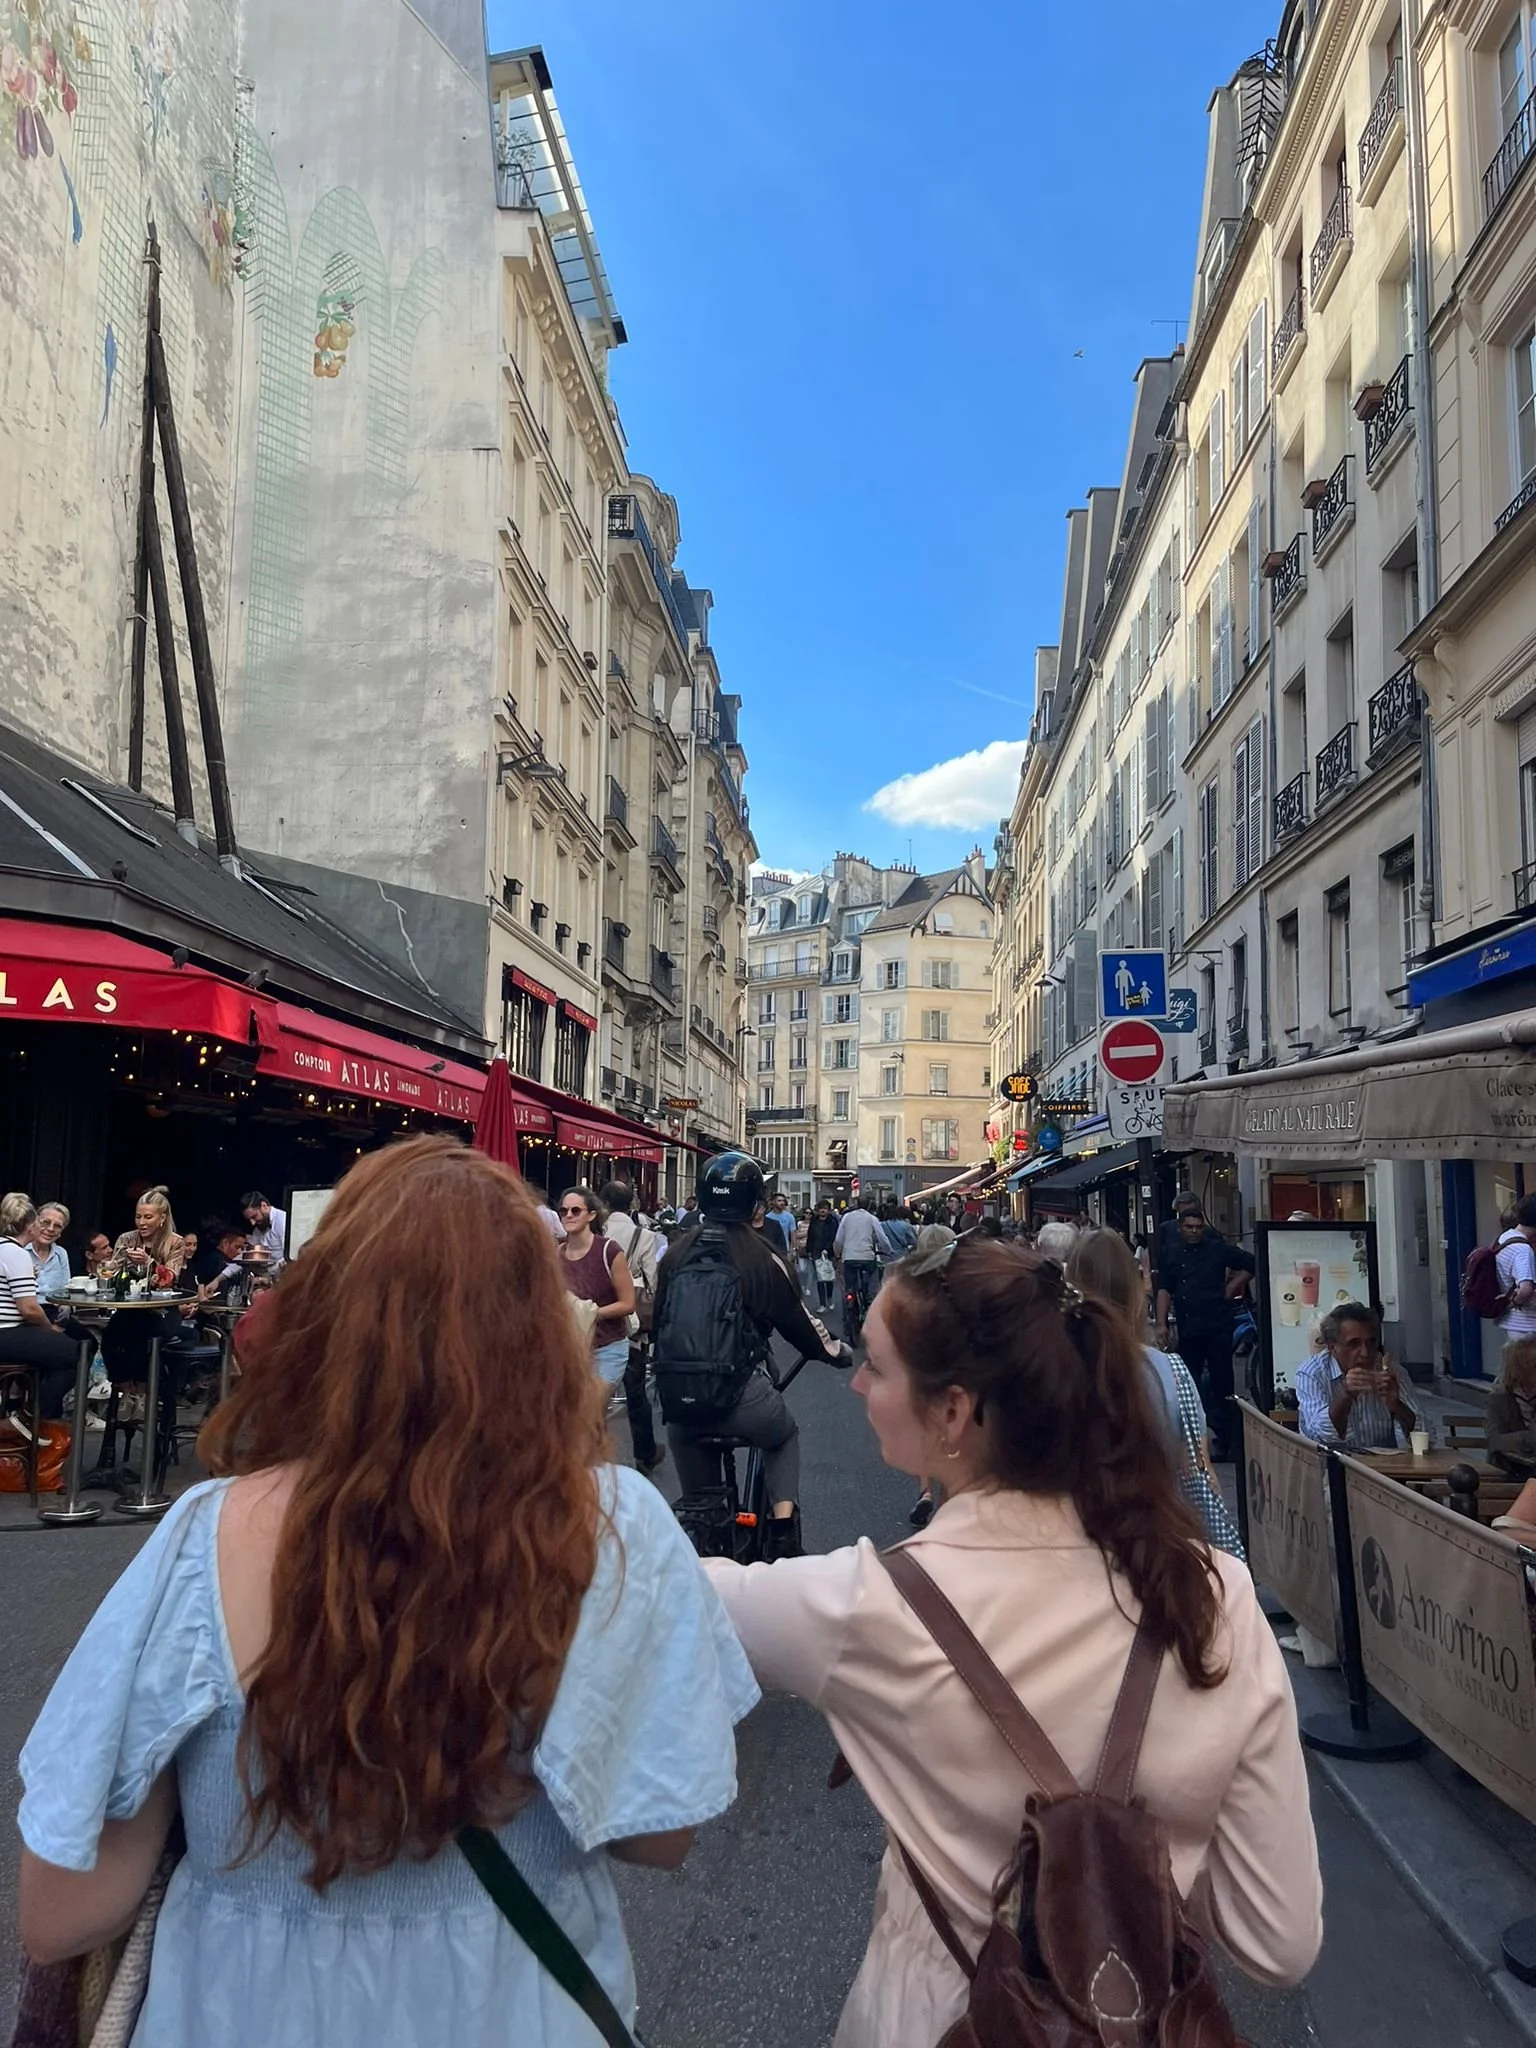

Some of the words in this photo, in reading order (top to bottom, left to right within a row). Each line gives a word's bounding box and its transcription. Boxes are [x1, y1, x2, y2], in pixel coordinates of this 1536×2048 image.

[294, 1051, 332, 1073] COMPTOIR
[341, 1059, 391, 1093] ATLAS
[437, 1088, 470, 1115] ATLAS
[1486, 1077, 1523, 1098] Glace
[512, 1106, 529, 1126] LAS
[1245, 1106, 1281, 1133] GELATO
[1281, 1105, 1295, 1131] AL
[1295, 1100, 1356, 1132] NATURALE
[1398, 1562, 1519, 1692] Amorino
